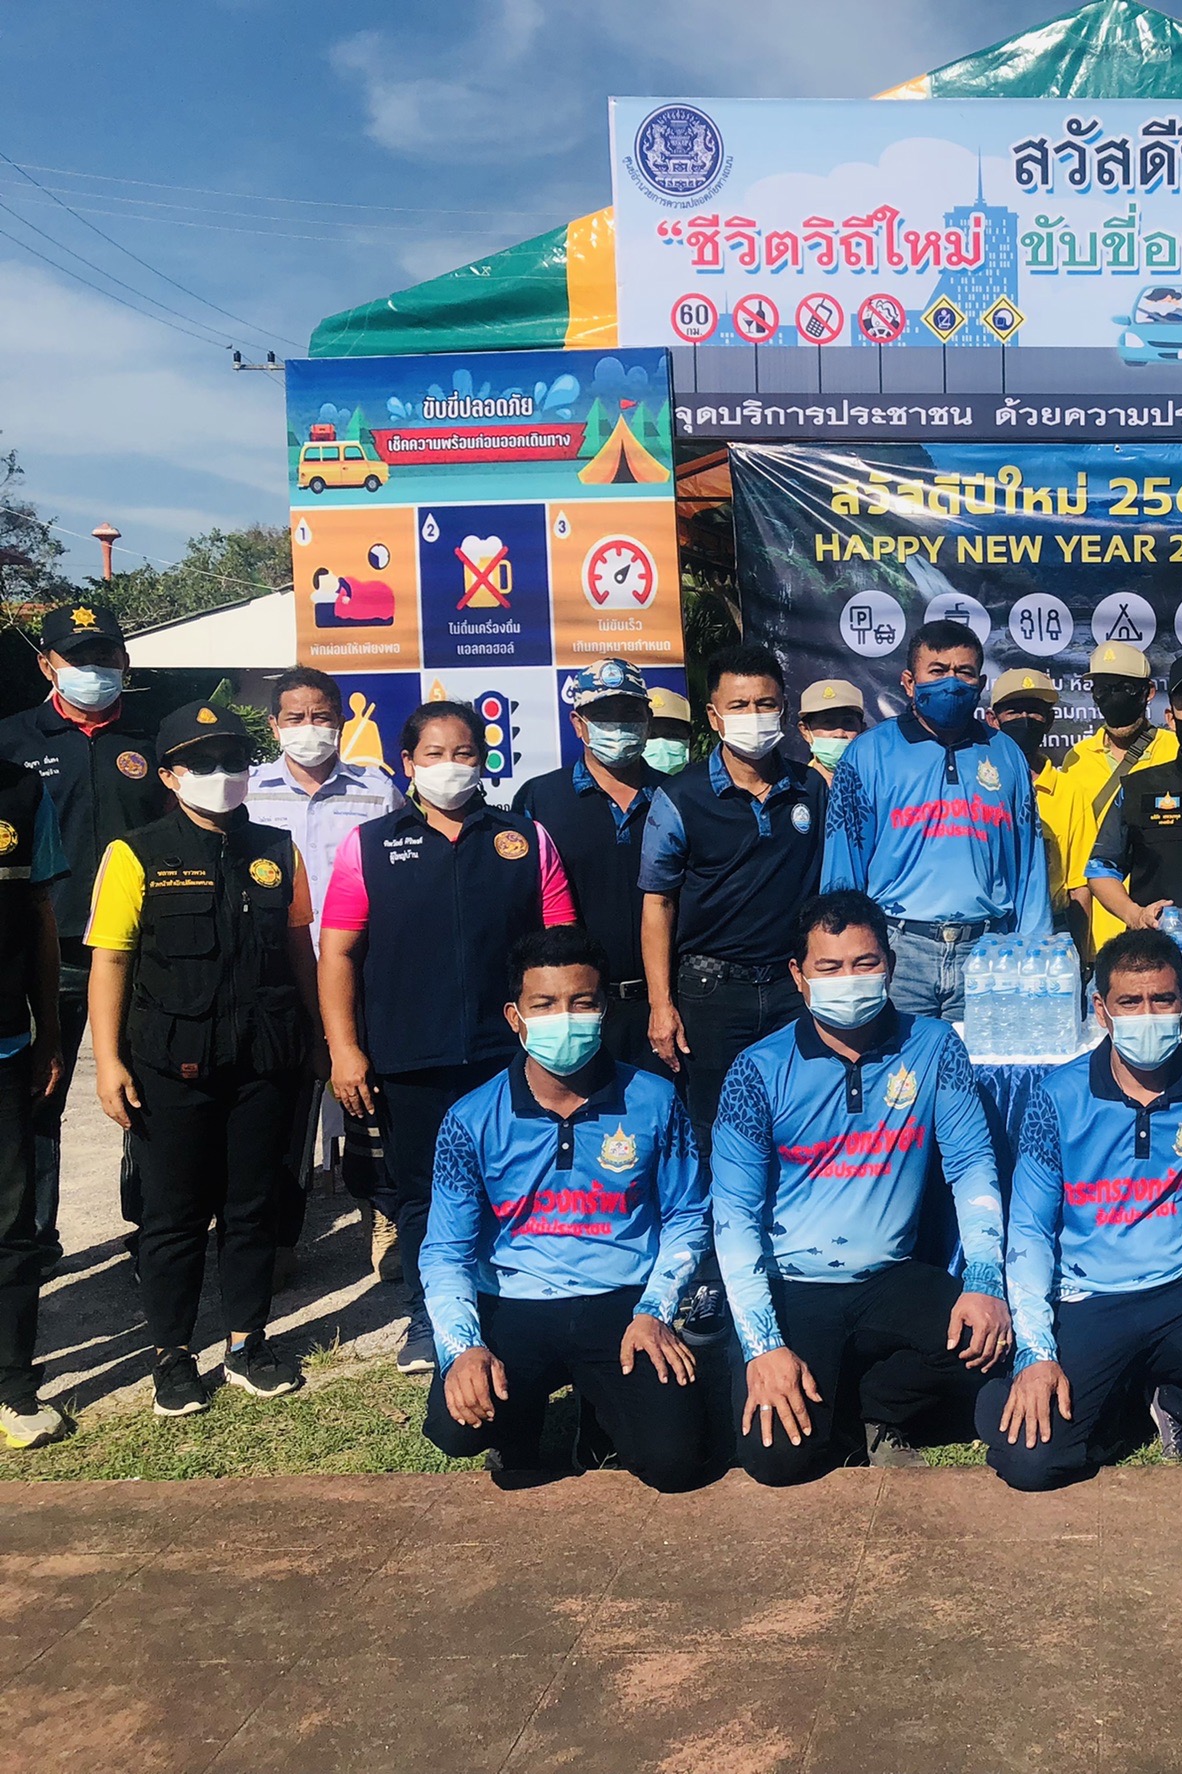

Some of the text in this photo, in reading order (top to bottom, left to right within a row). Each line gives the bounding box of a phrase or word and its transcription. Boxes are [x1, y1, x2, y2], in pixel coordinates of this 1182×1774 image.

[680, 303, 709, 325] 60
[422, 390, 533, 419] ขับขี่ปลอดภัย
[675, 399, 974, 436] จุดบริการประชาชน
[388, 430, 571, 454] เช็คความพร้อมก่อนออกเดินทาง
[830, 465, 1087, 517] สวัสดีปีใหม่
[300, 527, 307, 540] 1
[426, 524, 435, 537] 2
[557, 520, 566, 533] 3
[815, 533, 943, 564] HAPPY
[957, 533, 1043, 564] NEW
[1059, 533, 1157, 563] YEAR
[448, 620, 521, 636] ไม่ดื่มเครื่องดื่ม
[597, 617, 642, 633] ไม่ขับเร็ว
[309, 641, 400, 657] พักผ่อนให้เพียงพอ
[456, 640, 515, 657] แอลกอฮอล์
[571, 638, 671, 654] เกินกฎหมายกำหนด
